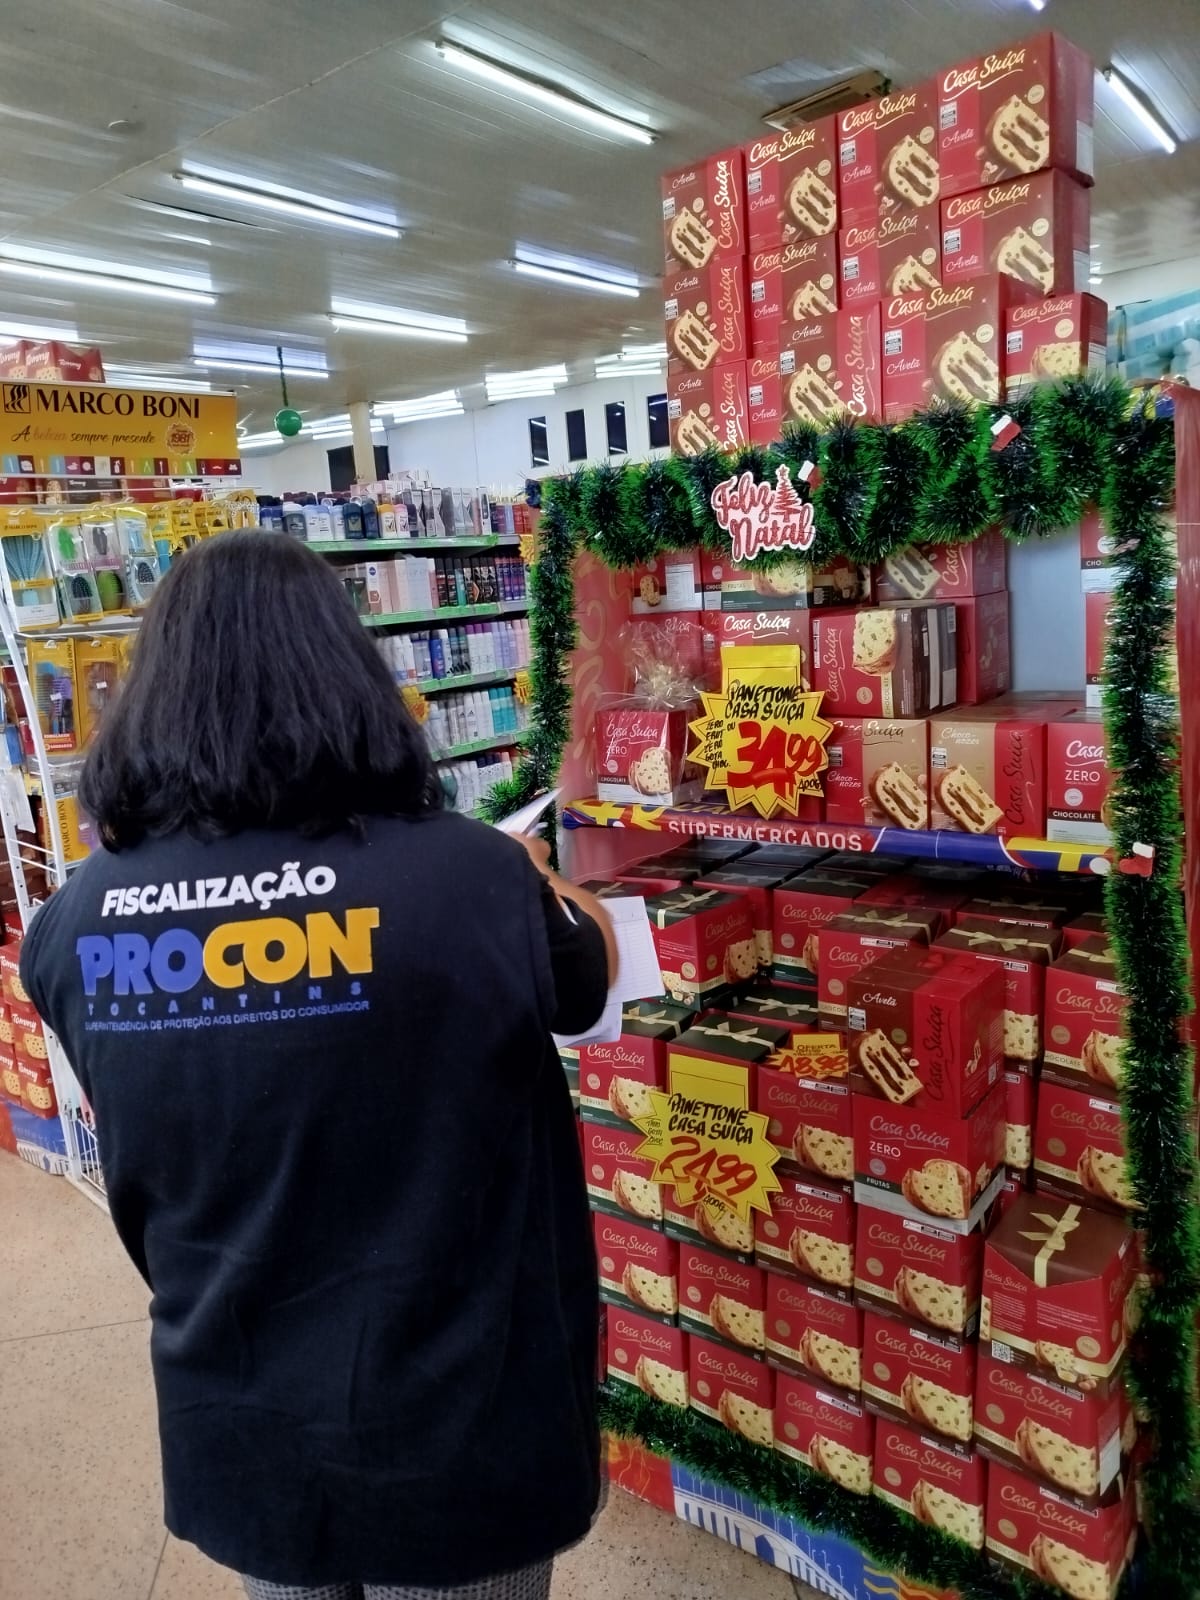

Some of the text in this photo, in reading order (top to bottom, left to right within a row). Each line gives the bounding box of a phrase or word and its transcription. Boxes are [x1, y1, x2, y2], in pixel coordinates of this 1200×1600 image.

[944, 49, 1026, 93] Casa Suíça
[842, 94, 916, 132] Casa Suíça
[750, 129, 815, 163] Casa Suíça
[942, 129, 974, 148] Avelã
[672, 172, 696, 188] Avelã
[843, 166, 872, 183] Avelã
[947, 184, 1030, 219] Casa Suíça
[718, 212, 733, 248] Casa
[846, 215, 919, 247] Casa Suíça
[754, 243, 817, 271] Casa Suíça
[946, 255, 979, 272] Avelã
[675, 278, 698, 291] Avelã
[846, 283, 876, 297] Avelã
[754, 304, 779, 318] Avelã
[888, 287, 974, 319] Casa Suíça
[1013, 307, 1037, 321] Casa
[721, 317, 735, 352] Casa
[792, 325, 822, 340] Avelã
[26, 352, 50, 366] Tommy
[752, 360, 778, 376] Casa
[887, 359, 920, 375] Avelã
[678, 379, 702, 391] Avelã
[37, 389, 199, 419] MARCO BONI
[848, 374, 867, 416] Casa
[12, 425, 30, 442] A
[71, 432, 108, 445] sempre
[112, 431, 155, 445] presente
[730, 504, 812, 560] Natal
[724, 616, 751, 631] Casa
[754, 613, 790, 631] Suíça
[729, 679, 801, 703] PANETTONE
[826, 666, 840, 701] Casa
[725, 703, 758, 719] CASA
[607, 724, 628, 737] Casa
[1065, 741, 1103, 759] Casa
[1065, 770, 1100, 782] ZERO
[1005, 782, 1025, 825] Casa
[1053, 810, 1096, 820] CHOCOLATE
[668, 820, 862, 852] SUPERMERCADOS
[101, 861, 336, 917] FISCALIZAÇÃO
[782, 905, 808, 918] Casa
[76, 907, 380, 996] PROCON
[829, 946, 858, 962] Casa
[862, 993, 897, 1007] Avelã
[1056, 989, 1091, 1008] Casa
[12, 1014, 36, 1032] Tommy
[150, 1020, 162, 1030] DE
[164, 1016, 211, 1029] PROTEÇÃO
[213, 1015, 232, 1024] AOS
[234, 1010, 278, 1024] DIREITOS
[281, 1009, 295, 1019] DO
[298, 1001, 370, 1016] CONSUMIDOR
[587, 1044, 611, 1060] Casa
[18, 1063, 38, 1082] Tommy
[768, 1086, 799, 1104] Casa
[1050, 1103, 1085, 1124] Casa
[668, 1117, 706, 1137] CASA
[870, 1115, 902, 1135] Casa
[592, 1135, 615, 1151] Casa
[869, 1141, 900, 1158] ZERO
[866, 1177, 890, 1189] FRUTAS
[773, 1195, 793, 1208] asa
[602, 1228, 625, 1246] Casa
[868, 1224, 899, 1244] Casa
[688, 1257, 715, 1277] Casa
[984, 1268, 1002, 1282] Casa
[777, 1288, 805, 1308] Casa
[616, 1321, 639, 1337] Casa
[875, 1329, 906, 1352] Casa
[698, 1352, 724, 1372] Casa
[989, 1370, 1024, 1395] Casa
[786, 1392, 813, 1413] Casa
[886, 1435, 918, 1459] Casa
[1001, 1485, 1035, 1511] Casa
